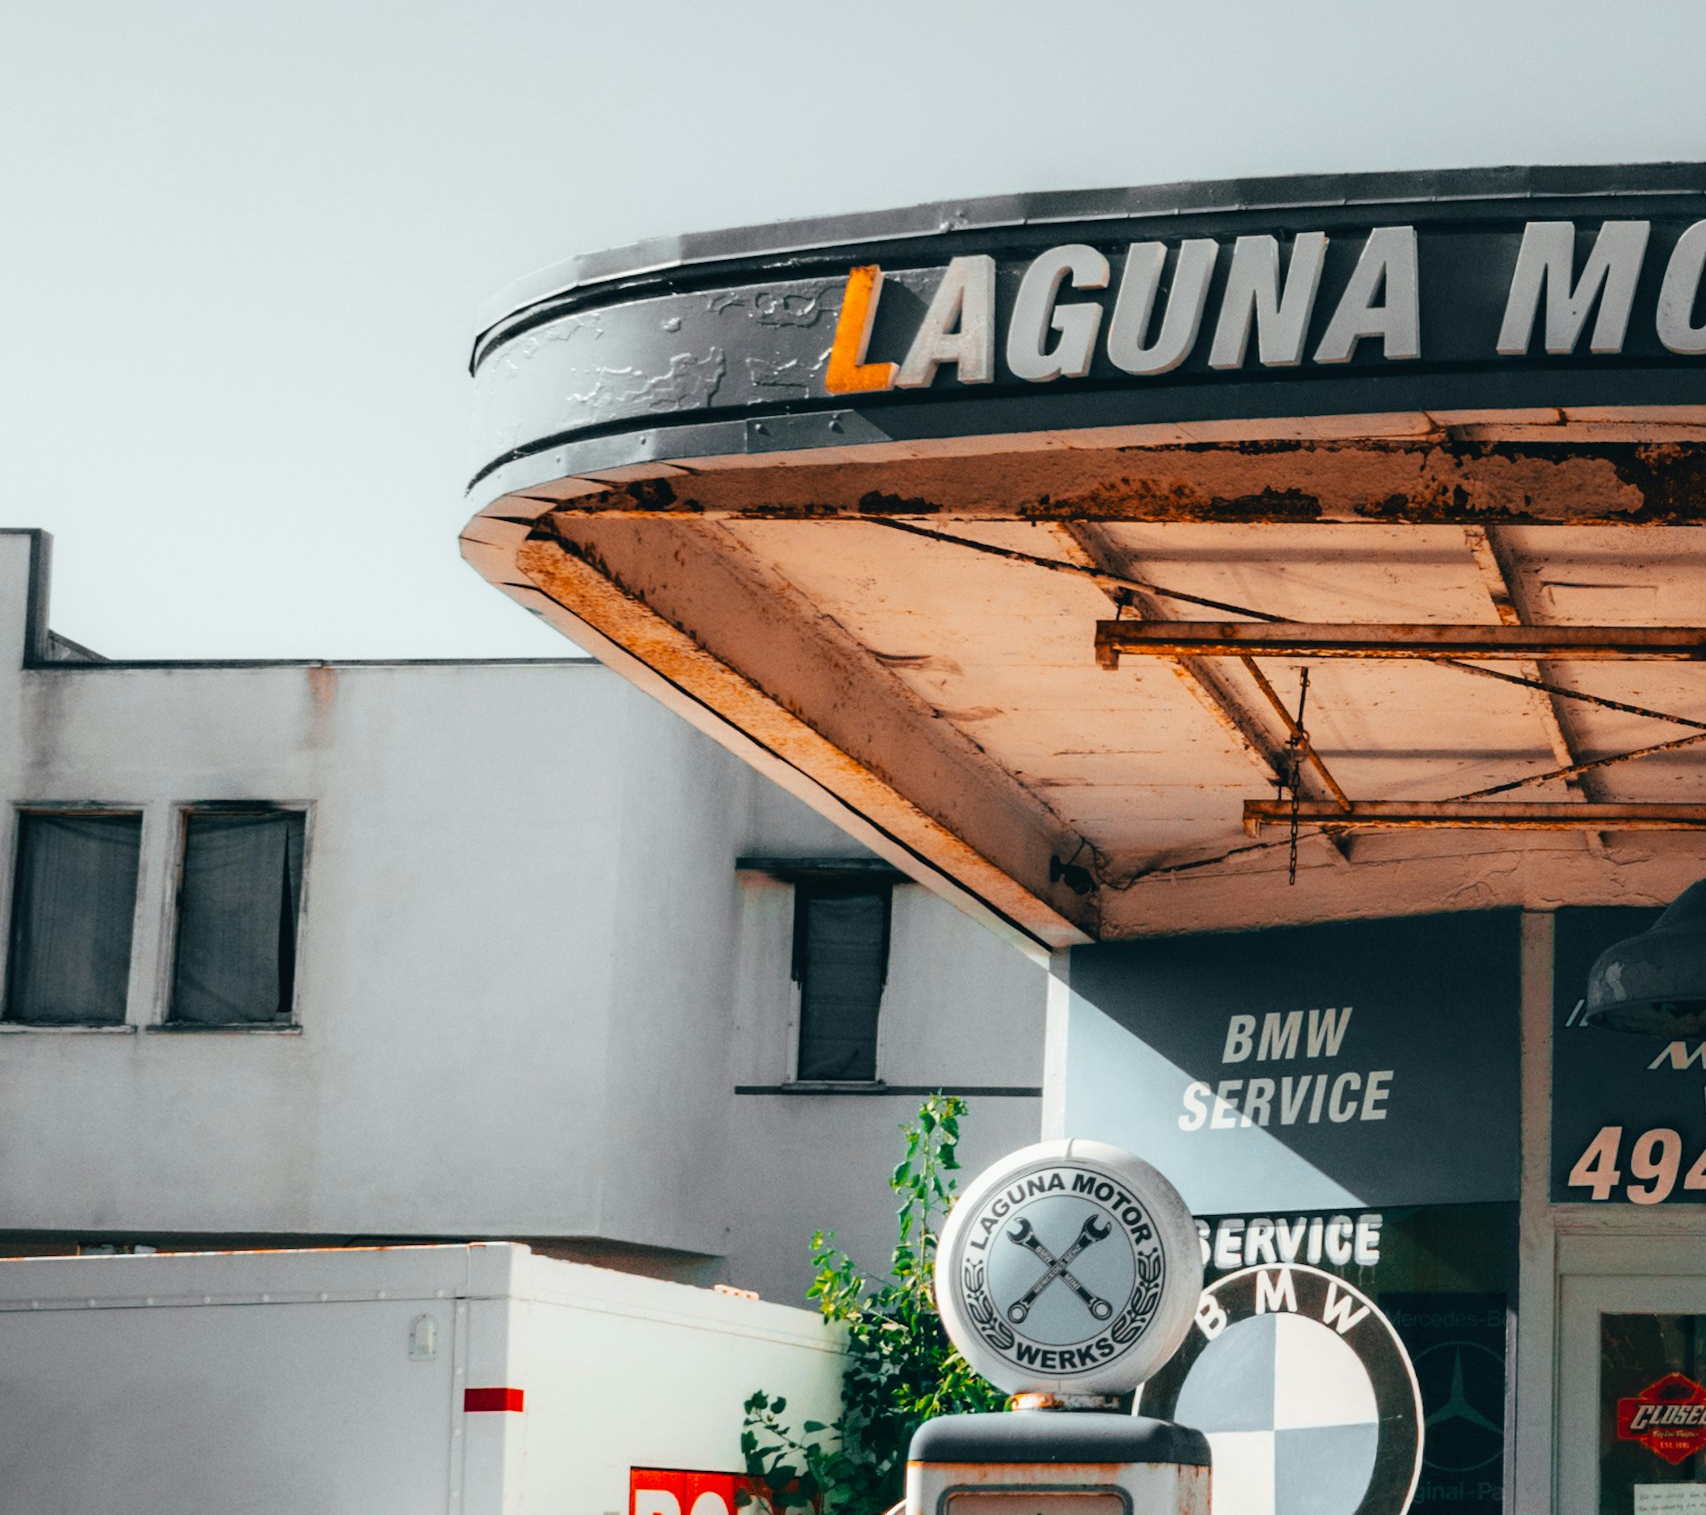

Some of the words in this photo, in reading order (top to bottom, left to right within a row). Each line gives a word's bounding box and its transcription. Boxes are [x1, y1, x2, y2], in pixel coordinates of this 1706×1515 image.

[825, 225, 1419, 394] LAGUNA
[1221, 1007, 1353, 1064] BMW
[1177, 1070, 1395, 1133] SERVICE
[970, 1172, 1066, 1251] LAGUNA
[1071, 1173, 1153, 1246] MOTOR
[1016, 1337, 1116, 1370] WERKS
